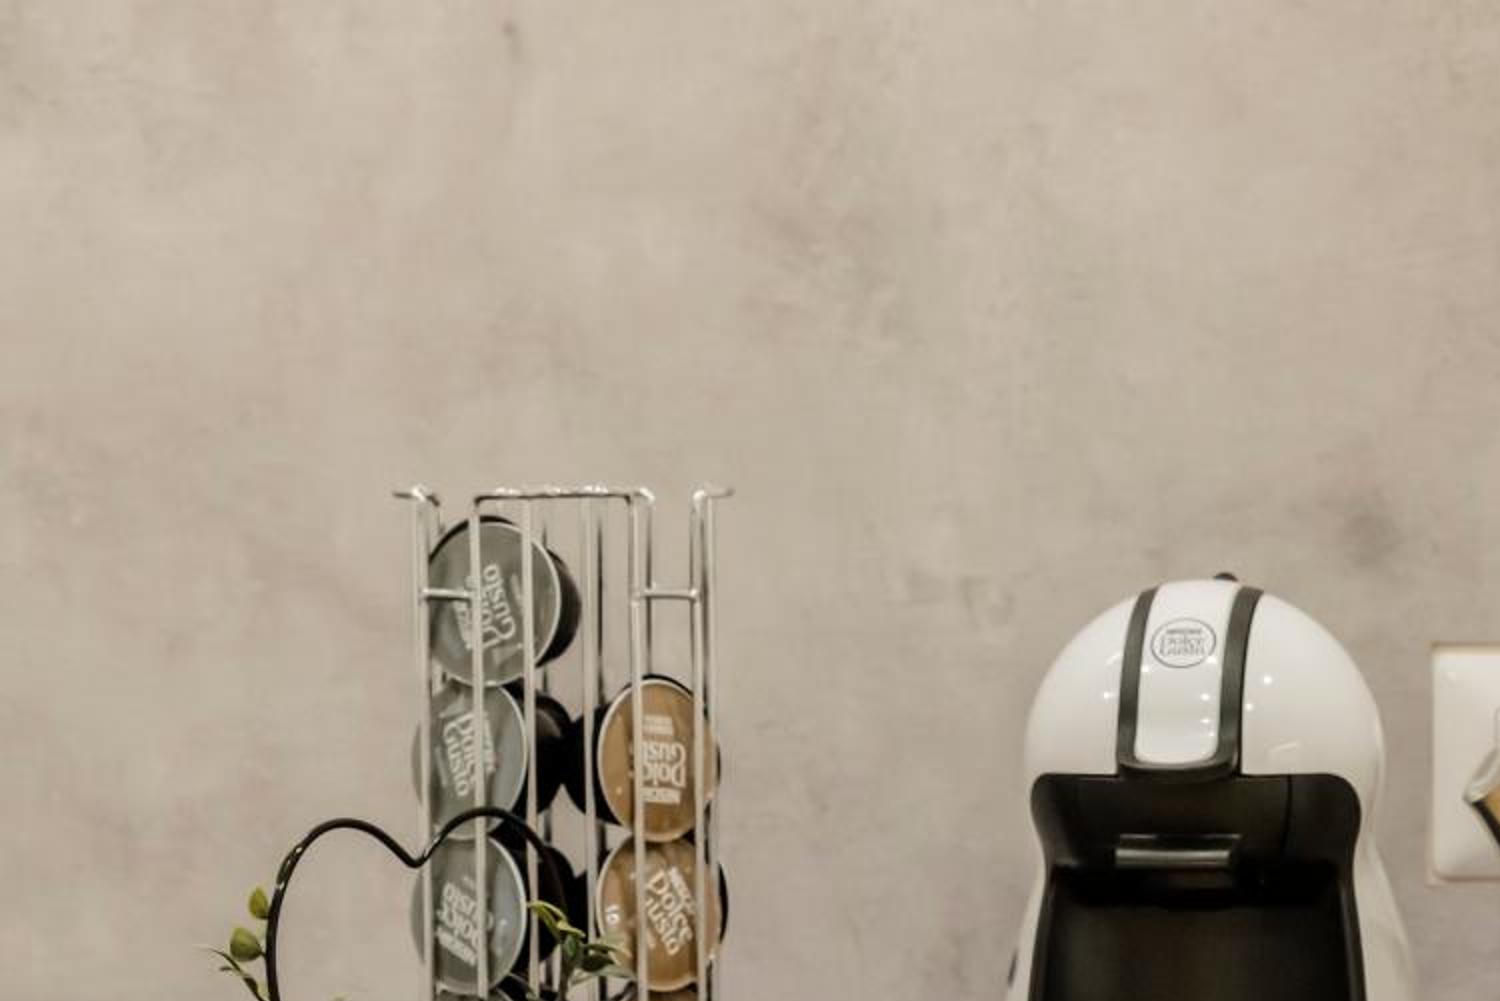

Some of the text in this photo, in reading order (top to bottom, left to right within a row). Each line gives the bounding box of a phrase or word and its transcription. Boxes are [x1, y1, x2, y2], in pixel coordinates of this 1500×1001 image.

[630, 741, 686, 765] Gust
[630, 762, 686, 788] Dolc
[646, 870, 693, 944] Dolce
